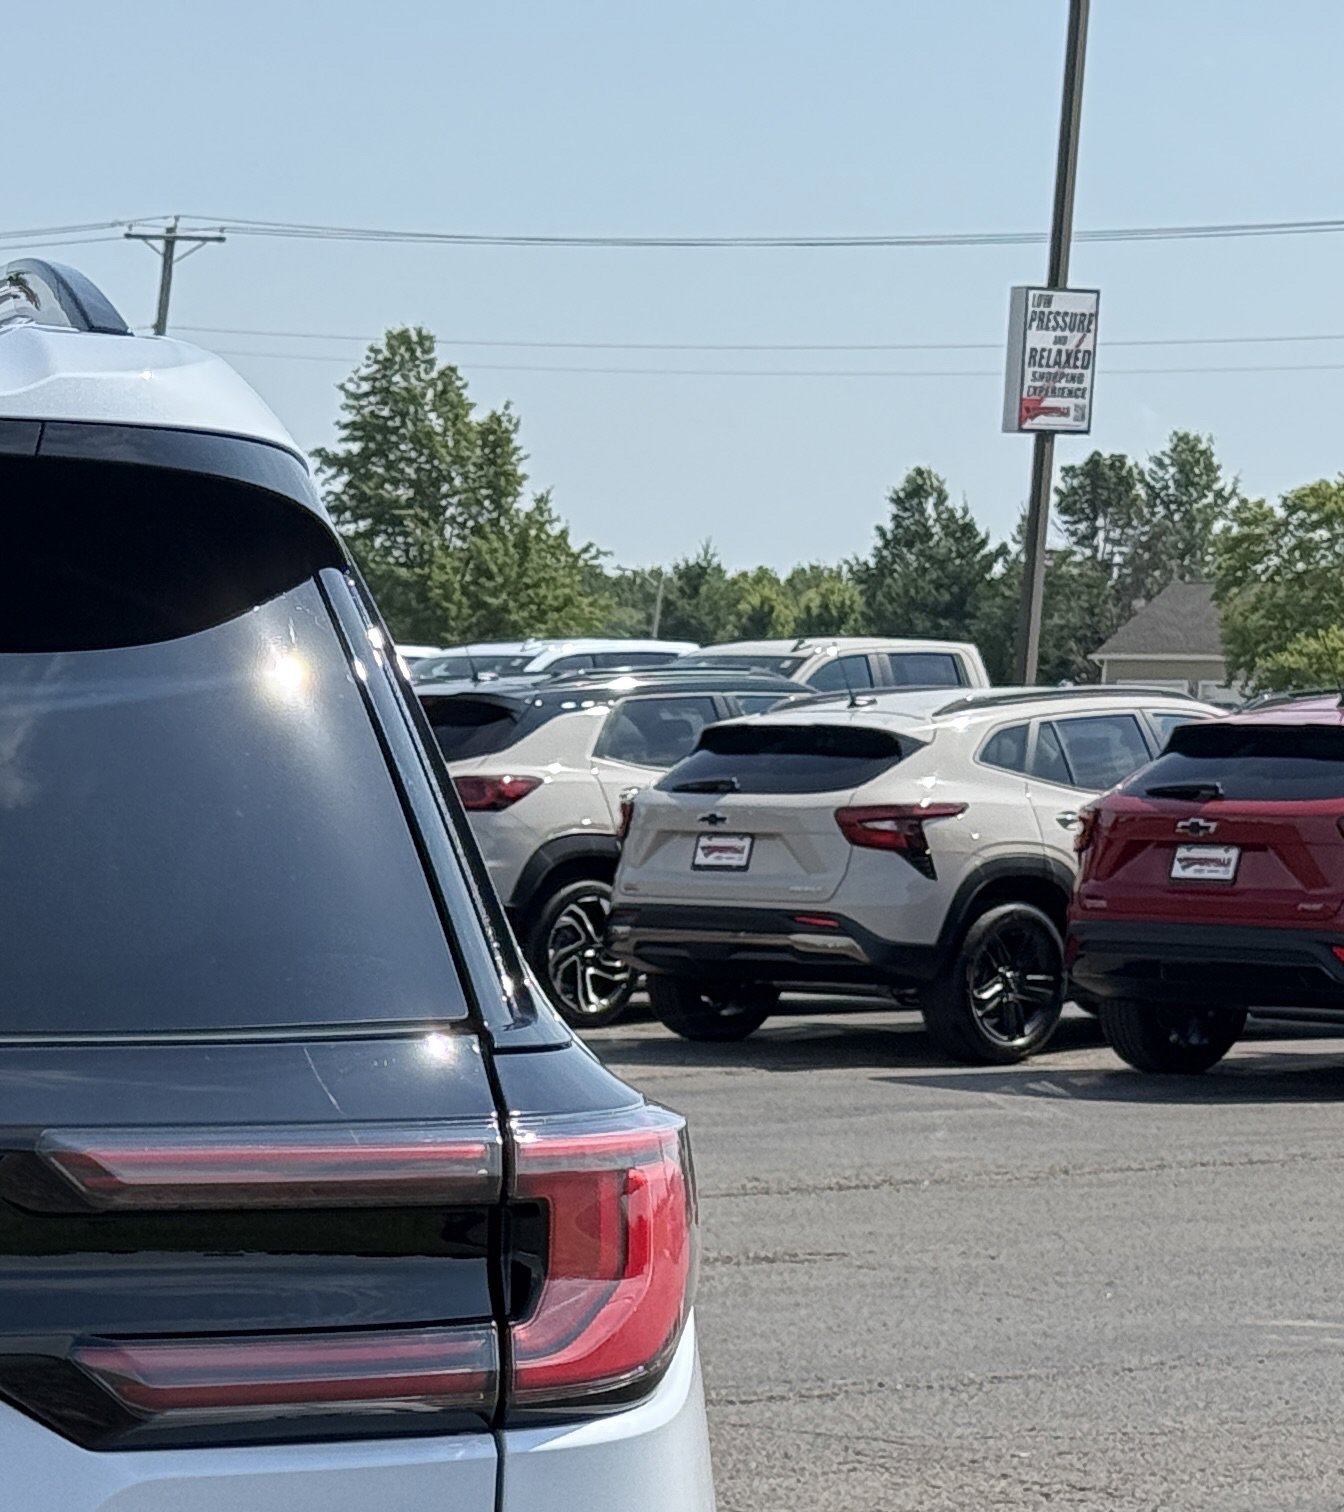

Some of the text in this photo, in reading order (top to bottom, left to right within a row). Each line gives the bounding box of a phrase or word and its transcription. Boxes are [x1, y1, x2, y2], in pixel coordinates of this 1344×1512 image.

[1027, 310, 1095, 334] PRESSURE
[1027, 347, 1092, 370] RELAXED
[1030, 371, 1085, 385] SHOPPING
[1026, 385, 1088, 400] EXPERIENCE
